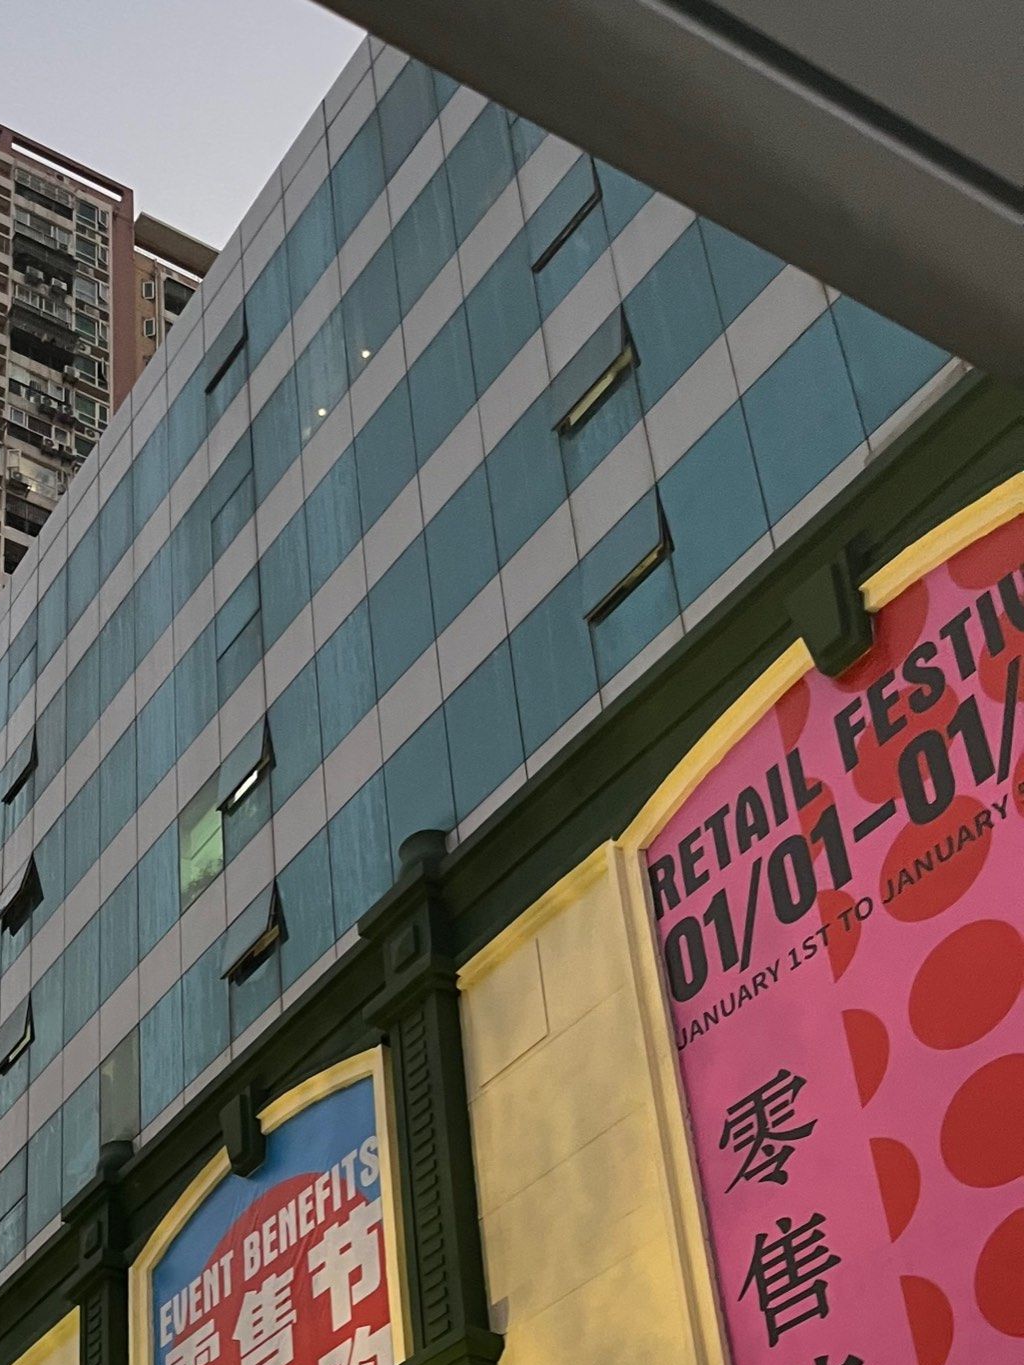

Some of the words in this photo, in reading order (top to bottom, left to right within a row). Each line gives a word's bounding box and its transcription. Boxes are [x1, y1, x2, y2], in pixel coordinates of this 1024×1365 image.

[647, 748, 822, 920] RETAIL
[677, 959, 781, 1051] JANUARY
[789, 923, 830, 972] 1ST
[838, 896, 874, 935] TO
[883, 794, 1008, 904] JANUARY
[160, 1250, 234, 1349] EVENT
[243, 1135, 381, 1282] BENEFITS
